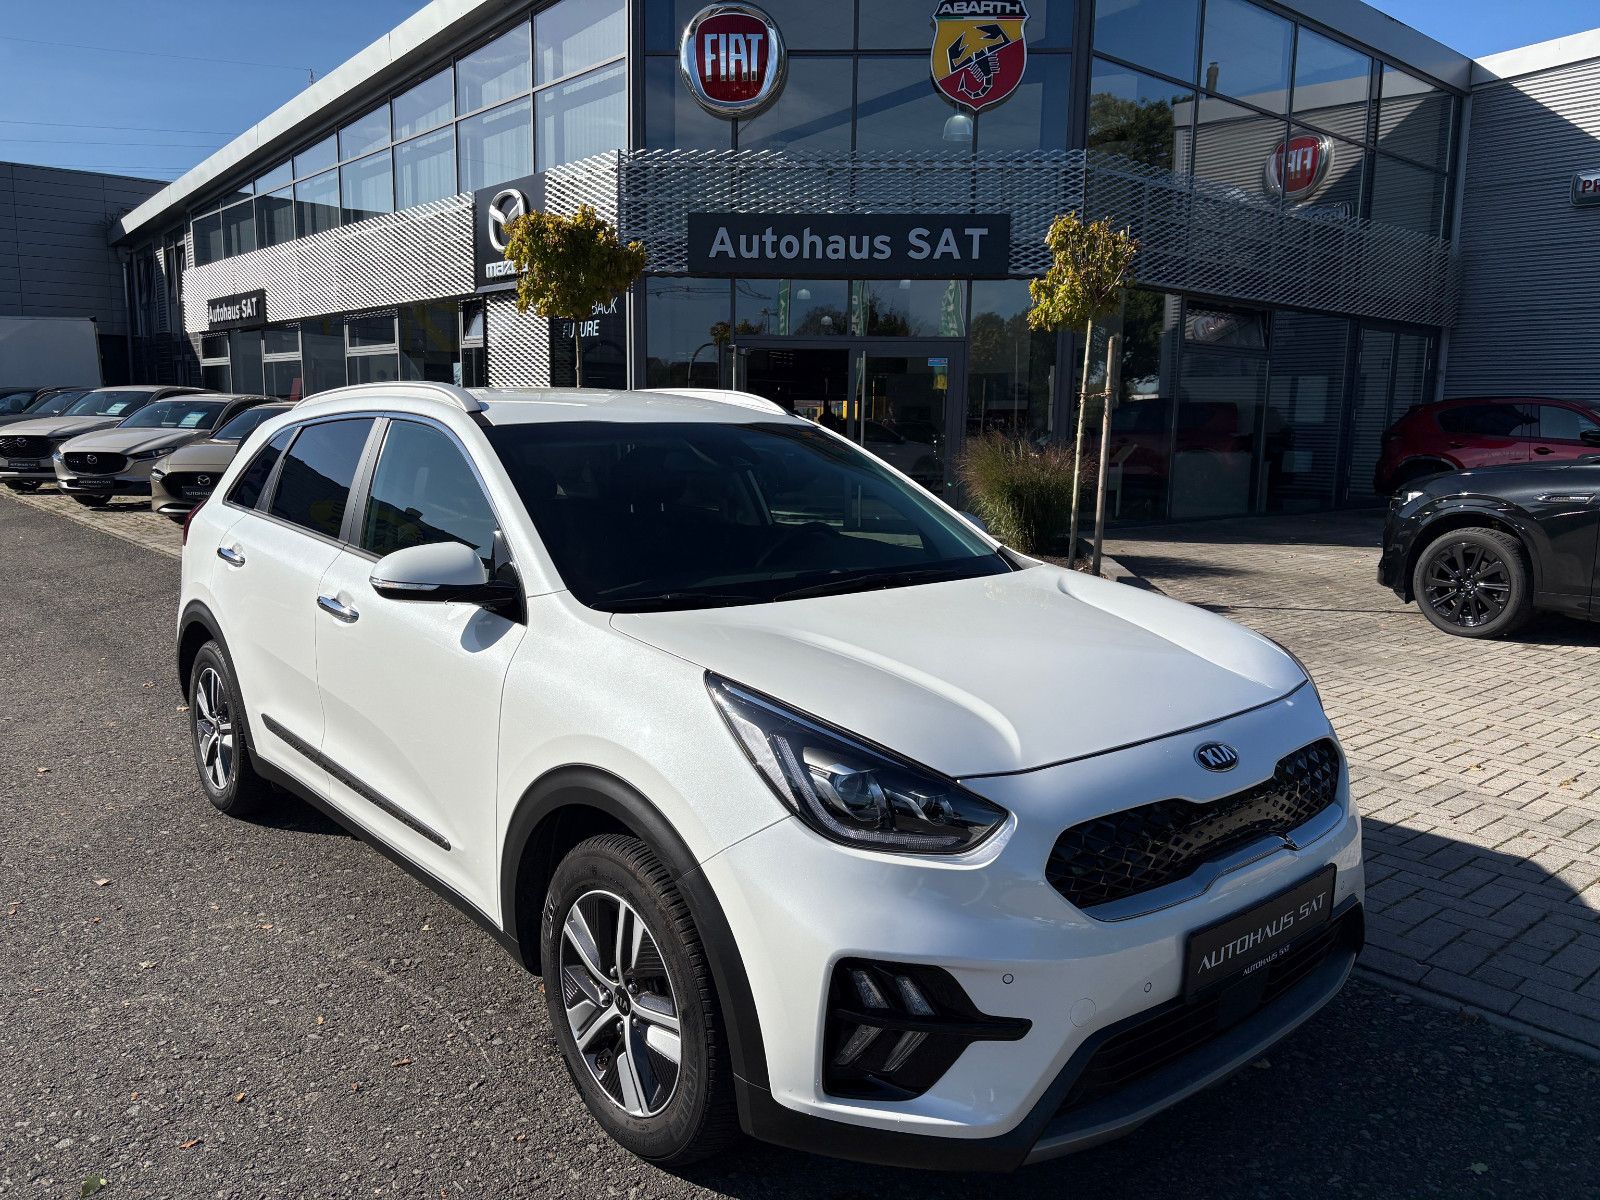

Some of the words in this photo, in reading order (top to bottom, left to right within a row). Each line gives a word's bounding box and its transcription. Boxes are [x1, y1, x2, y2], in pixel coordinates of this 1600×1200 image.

[938, 2, 1020, 14] ABARTH
[704, 33, 764, 82] FIAT
[708, 227, 893, 260] Autohaus
[907, 227, 989, 260] SAT
[208, 302, 241, 322] Autohaus
[241, 297, 257, 318] SAT
[562, 319, 600, 338] FUURE
[1200, 744, 1238, 767] KIA
[1197, 910, 1295, 974] AUTOHAUS
[1299, 891, 1327, 921] SAT
[1242, 950, 1278, 977] AUTOHAUS
[1278, 944, 1291, 960] SAT
